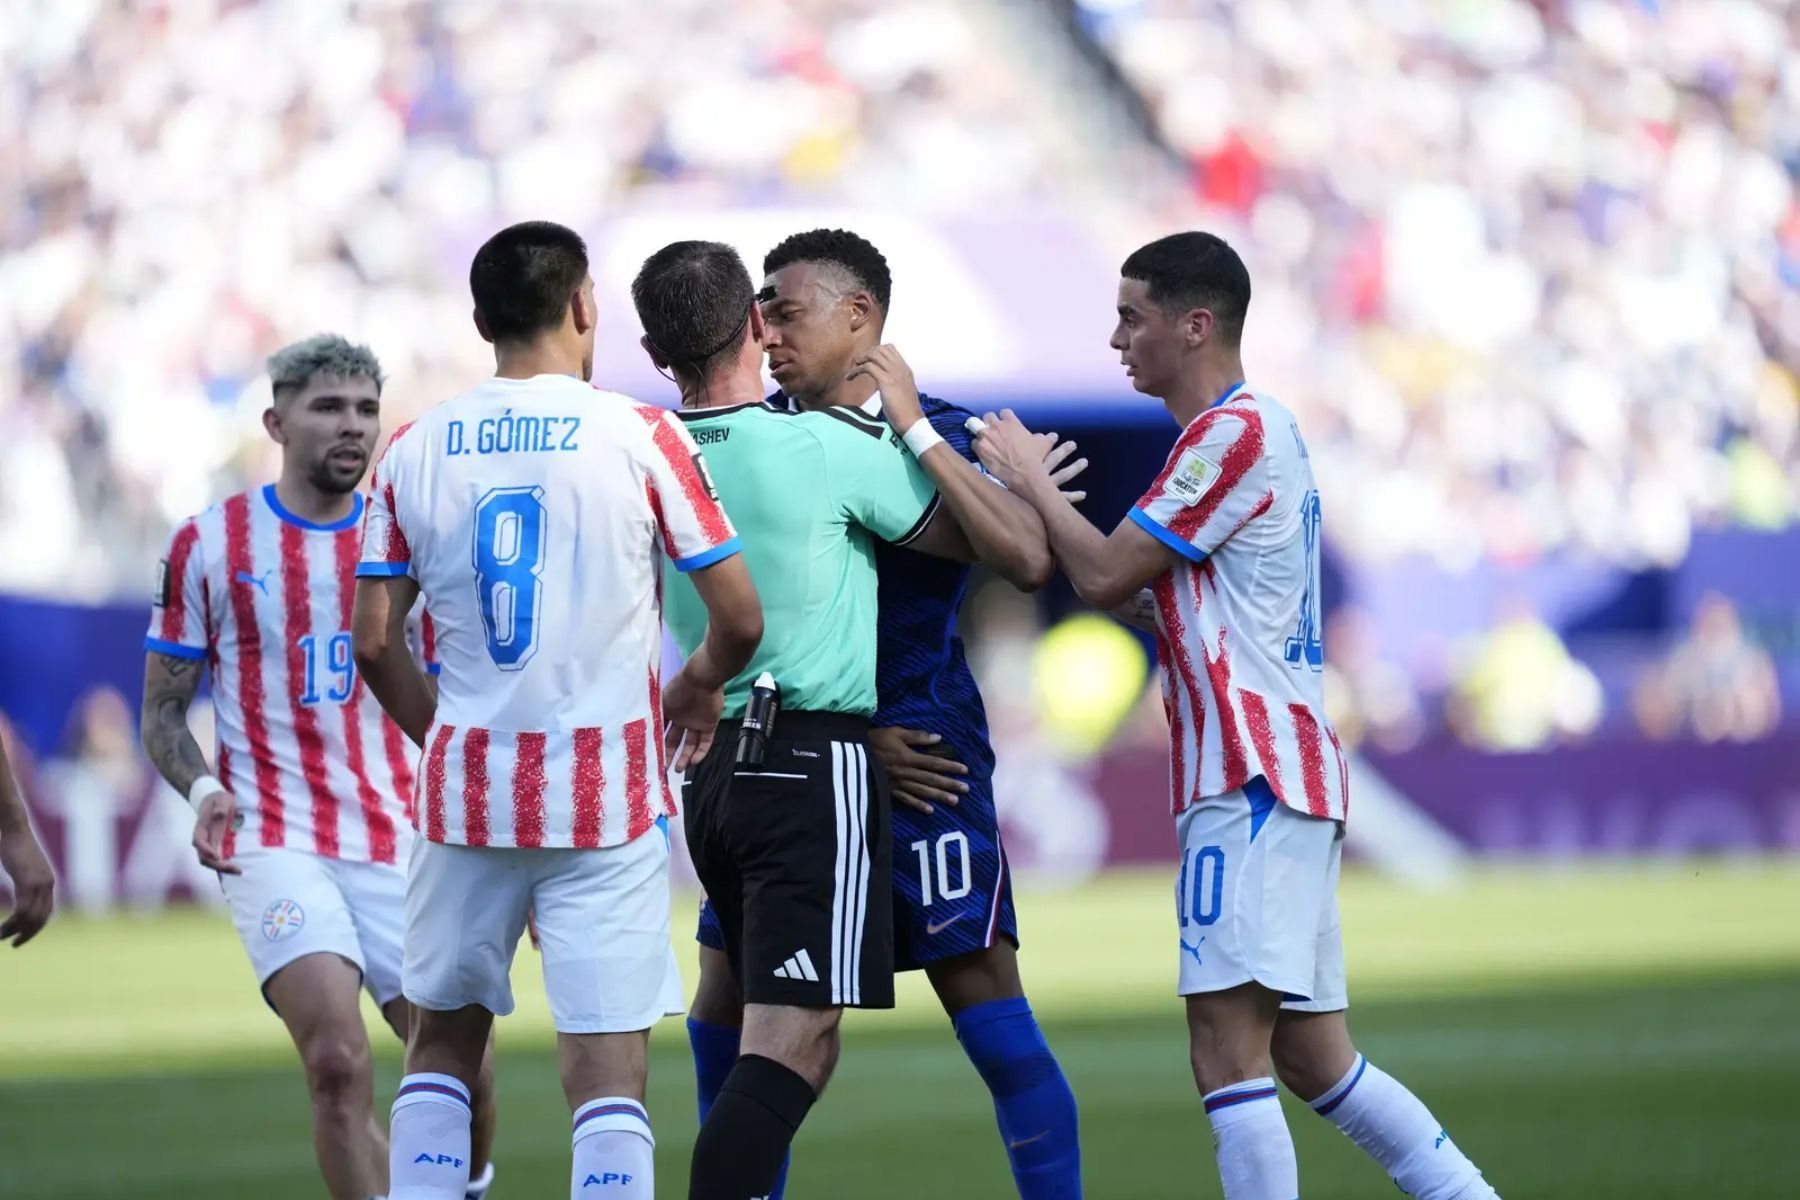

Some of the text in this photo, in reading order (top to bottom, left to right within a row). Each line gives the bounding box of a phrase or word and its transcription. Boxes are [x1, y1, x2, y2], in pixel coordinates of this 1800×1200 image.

[472, 485, 547, 671] 8
[299, 632, 354, 705] 19
[911, 830, 972, 907] 10
[1180, 846, 1225, 927] 10
[414, 1152, 463, 1169] APF
[583, 1172, 633, 1188] APF
